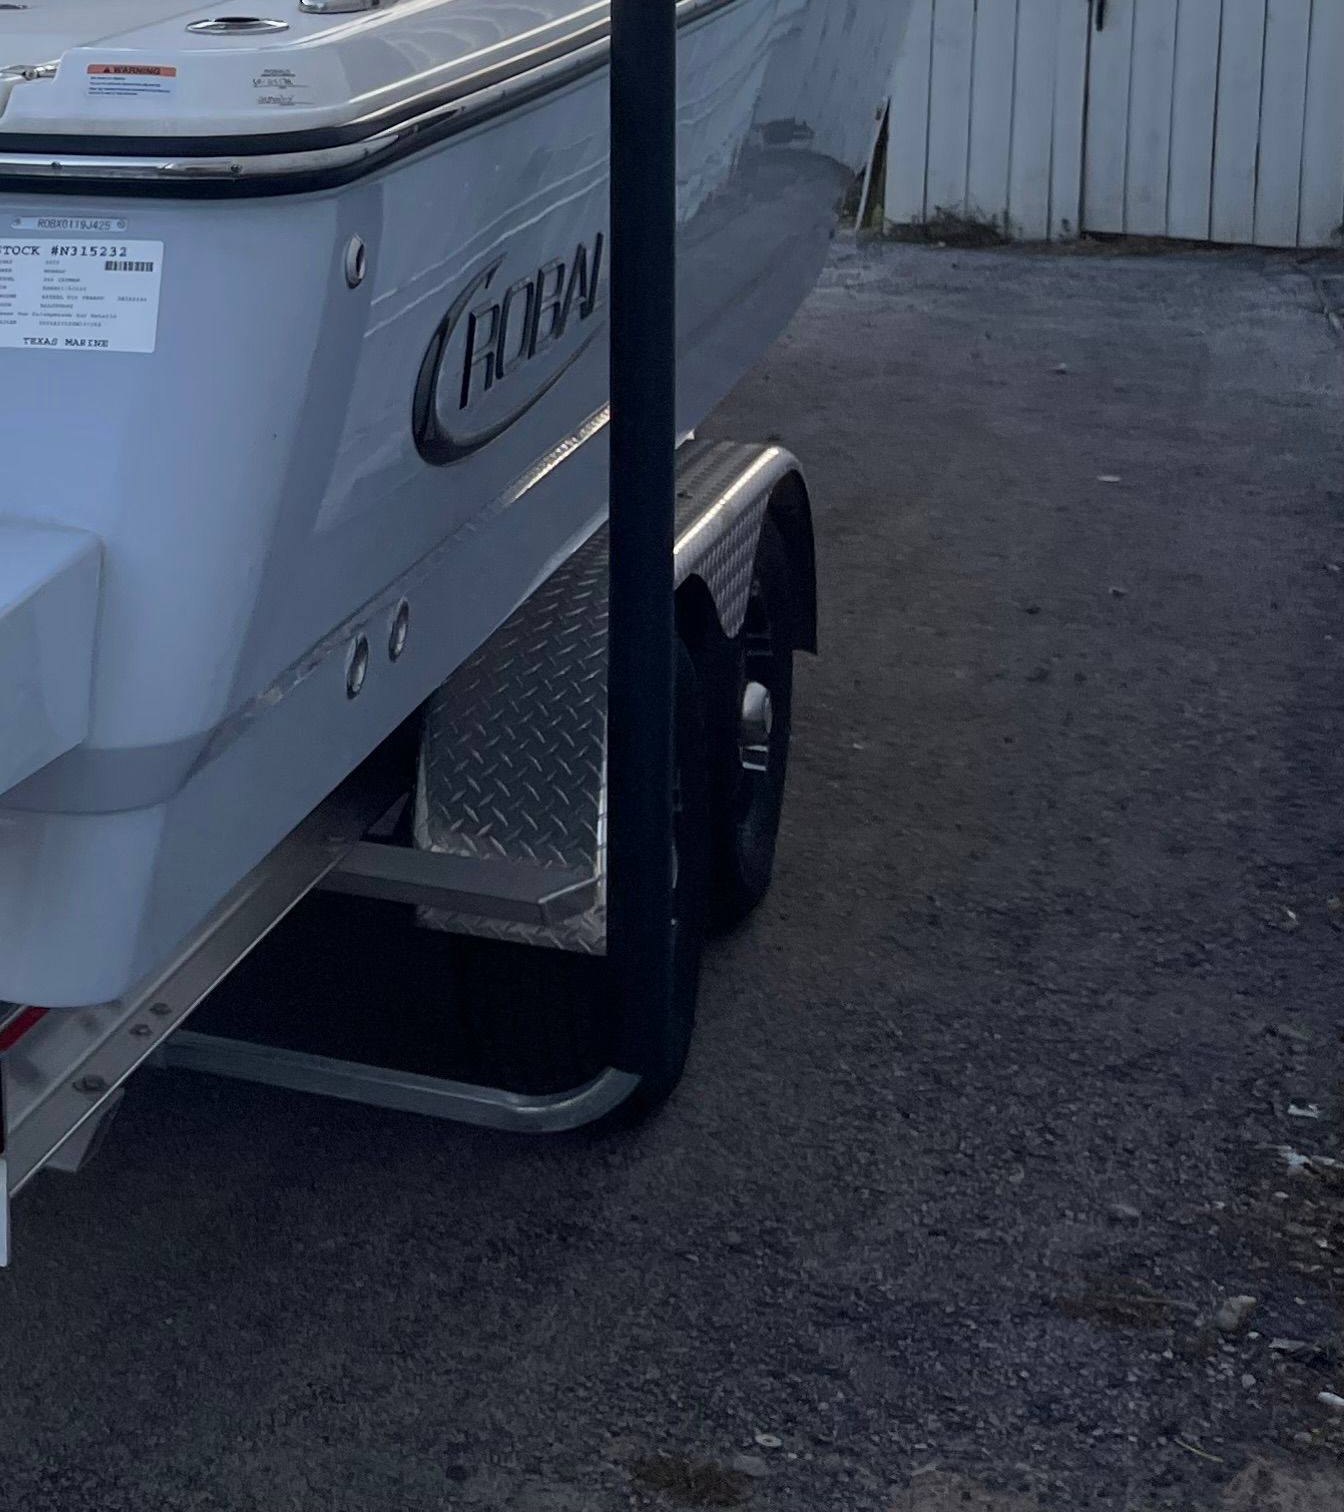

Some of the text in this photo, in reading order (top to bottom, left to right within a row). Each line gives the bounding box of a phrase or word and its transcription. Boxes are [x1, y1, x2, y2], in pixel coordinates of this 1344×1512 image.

[113, 66, 161, 75] WARNING
[50, 245, 128, 257] #N315232
[23, 337, 109, 348] TEXAS MARINE
